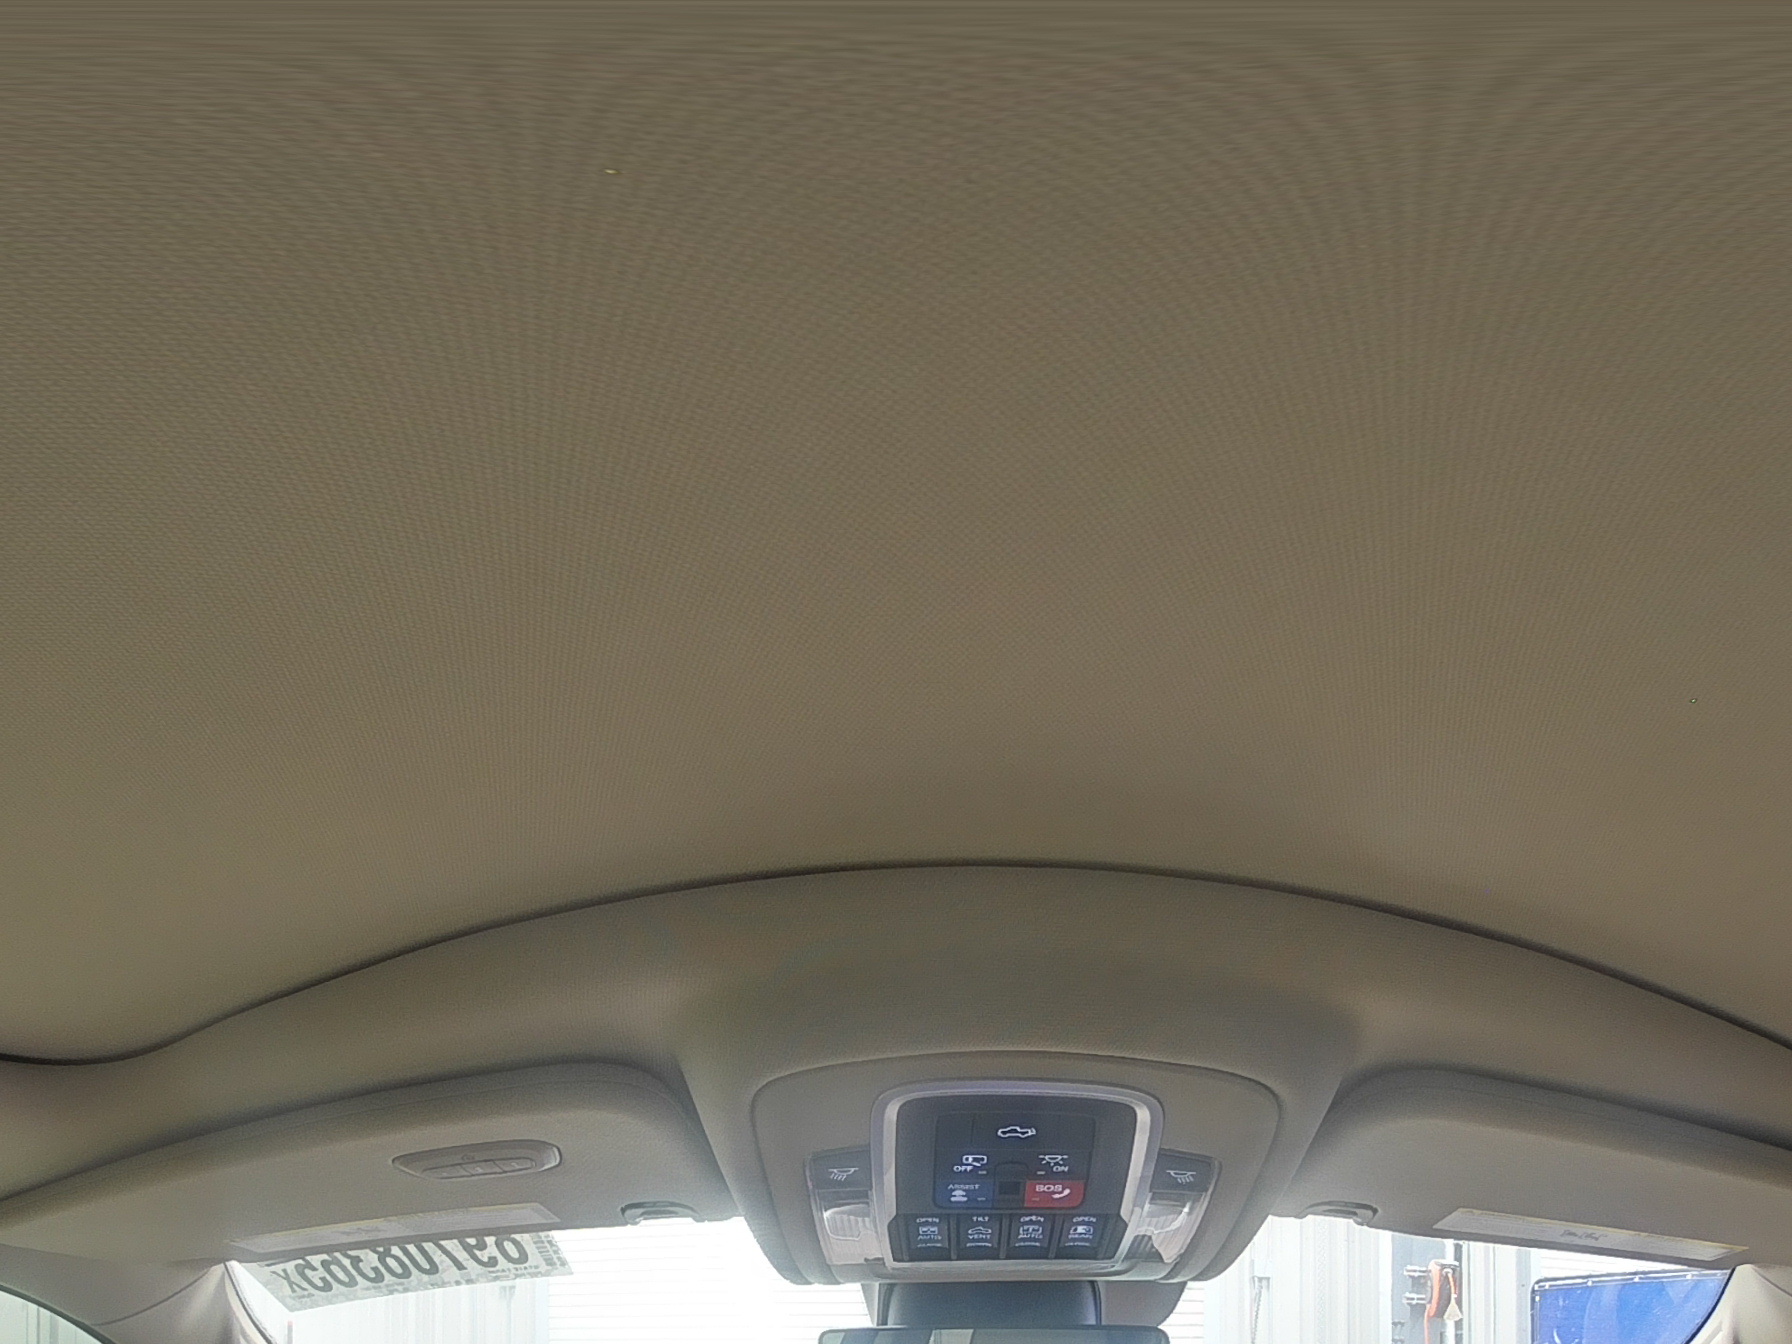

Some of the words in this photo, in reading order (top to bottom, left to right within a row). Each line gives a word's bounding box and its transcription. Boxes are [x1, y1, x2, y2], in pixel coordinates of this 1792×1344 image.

[953, 1165, 973, 1173] OFF
[1052, 1165, 1069, 1173] ON
[1035, 1184, 1063, 1192] SOS
